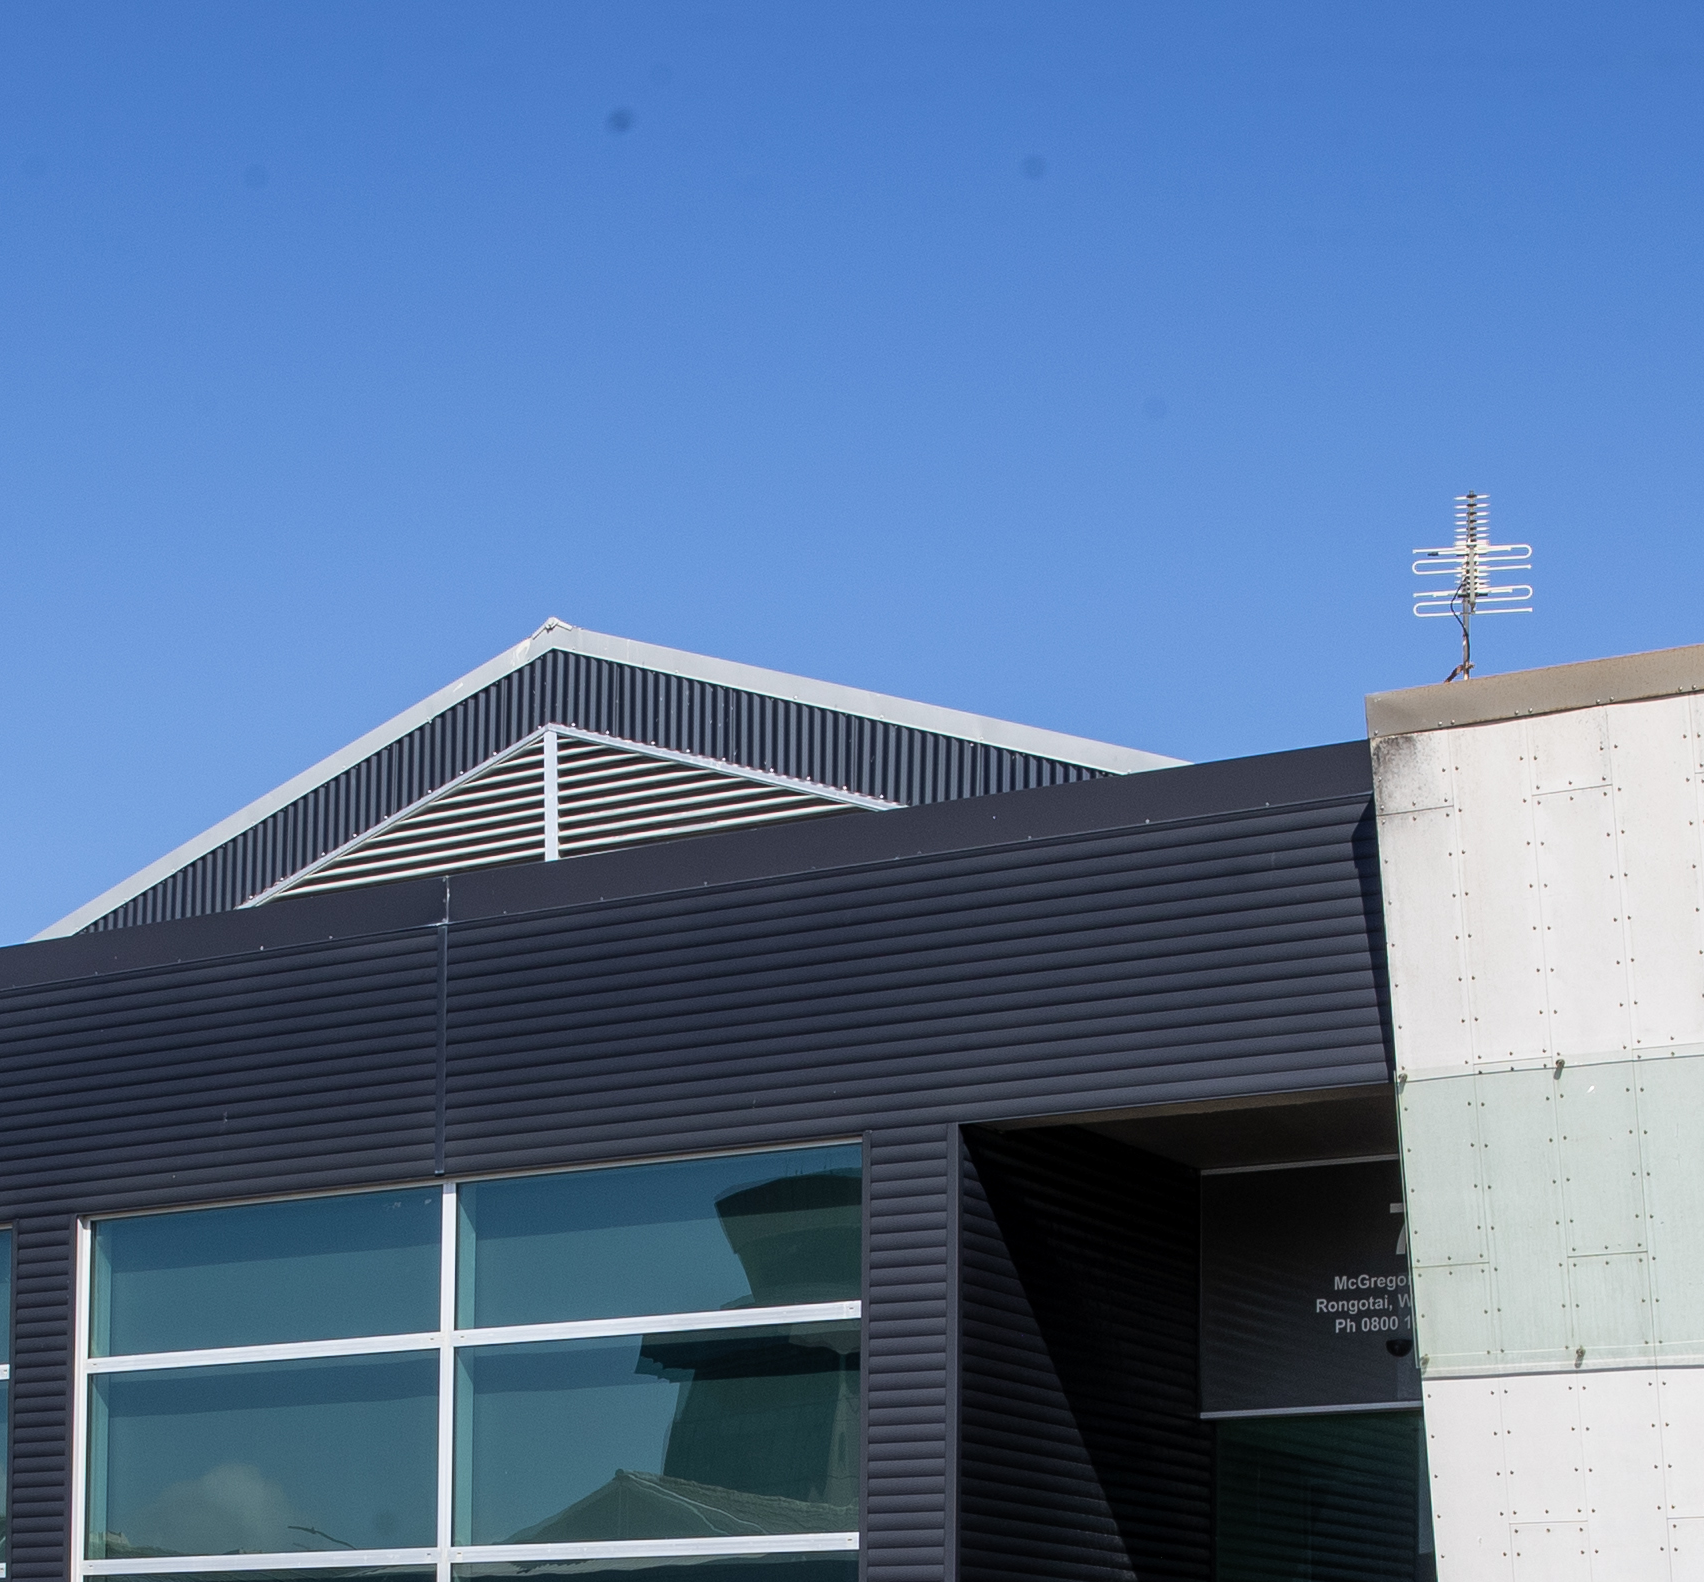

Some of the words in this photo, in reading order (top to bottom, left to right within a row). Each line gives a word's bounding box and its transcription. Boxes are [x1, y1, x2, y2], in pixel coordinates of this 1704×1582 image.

[1316, 1295, 1393, 1315] Rongotai,
[1335, 1318, 1356, 1333] Ph
[1361, 1316, 1399, 1332] 0800
[1404, 1315, 1411, 1330] 1
